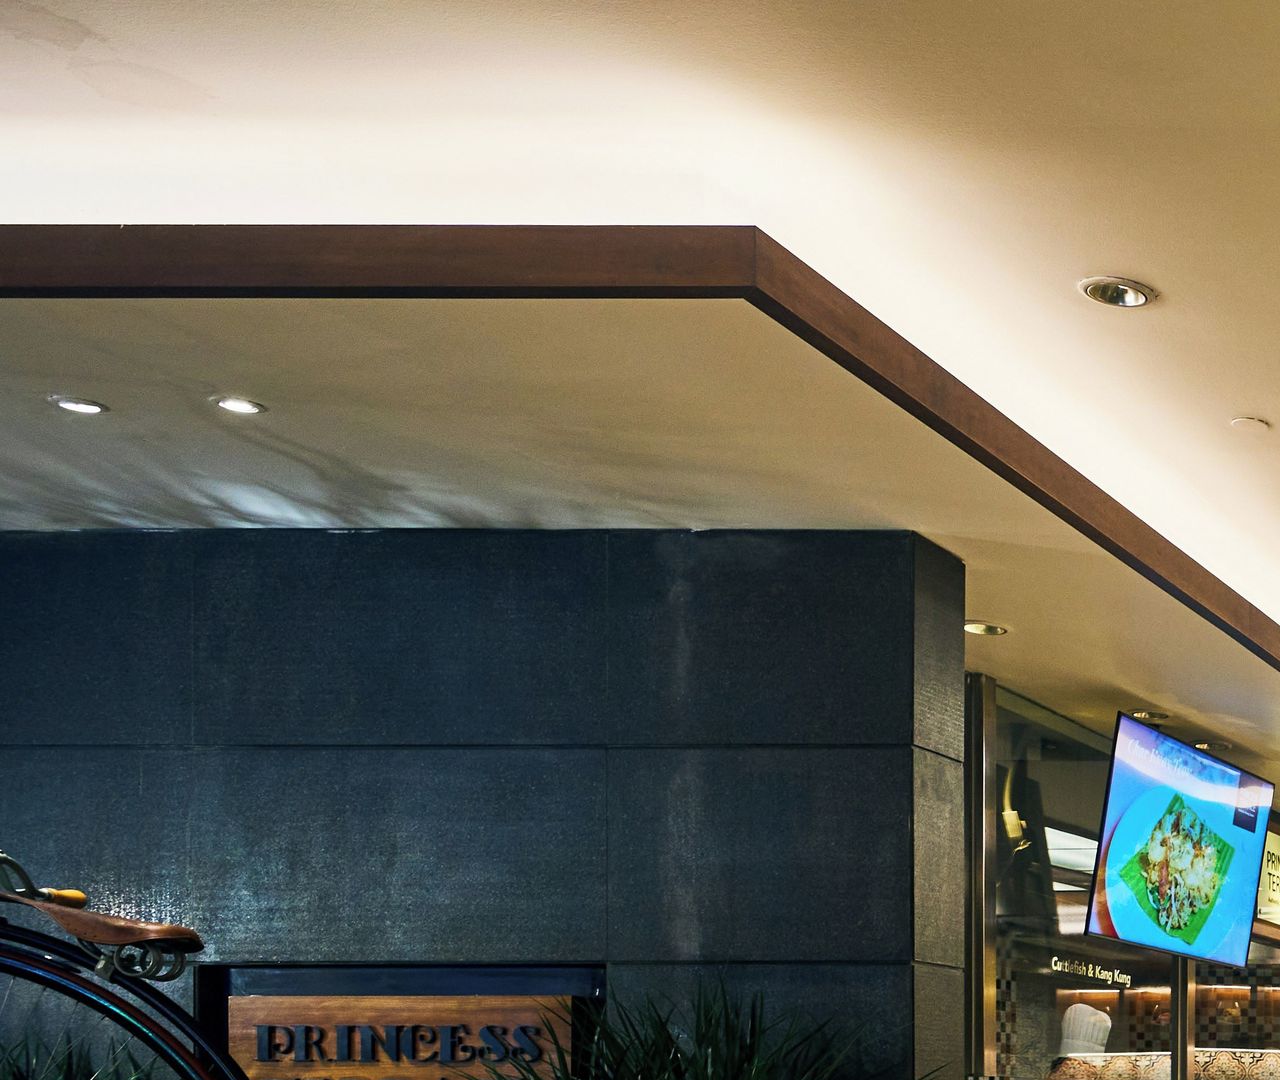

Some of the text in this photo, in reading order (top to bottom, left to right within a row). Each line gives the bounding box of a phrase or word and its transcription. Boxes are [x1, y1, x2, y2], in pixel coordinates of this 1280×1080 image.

[1051, 956, 1131, 988] Cuttlefish & Kang Kung
[254, 1024, 542, 1063] PRINCESS
